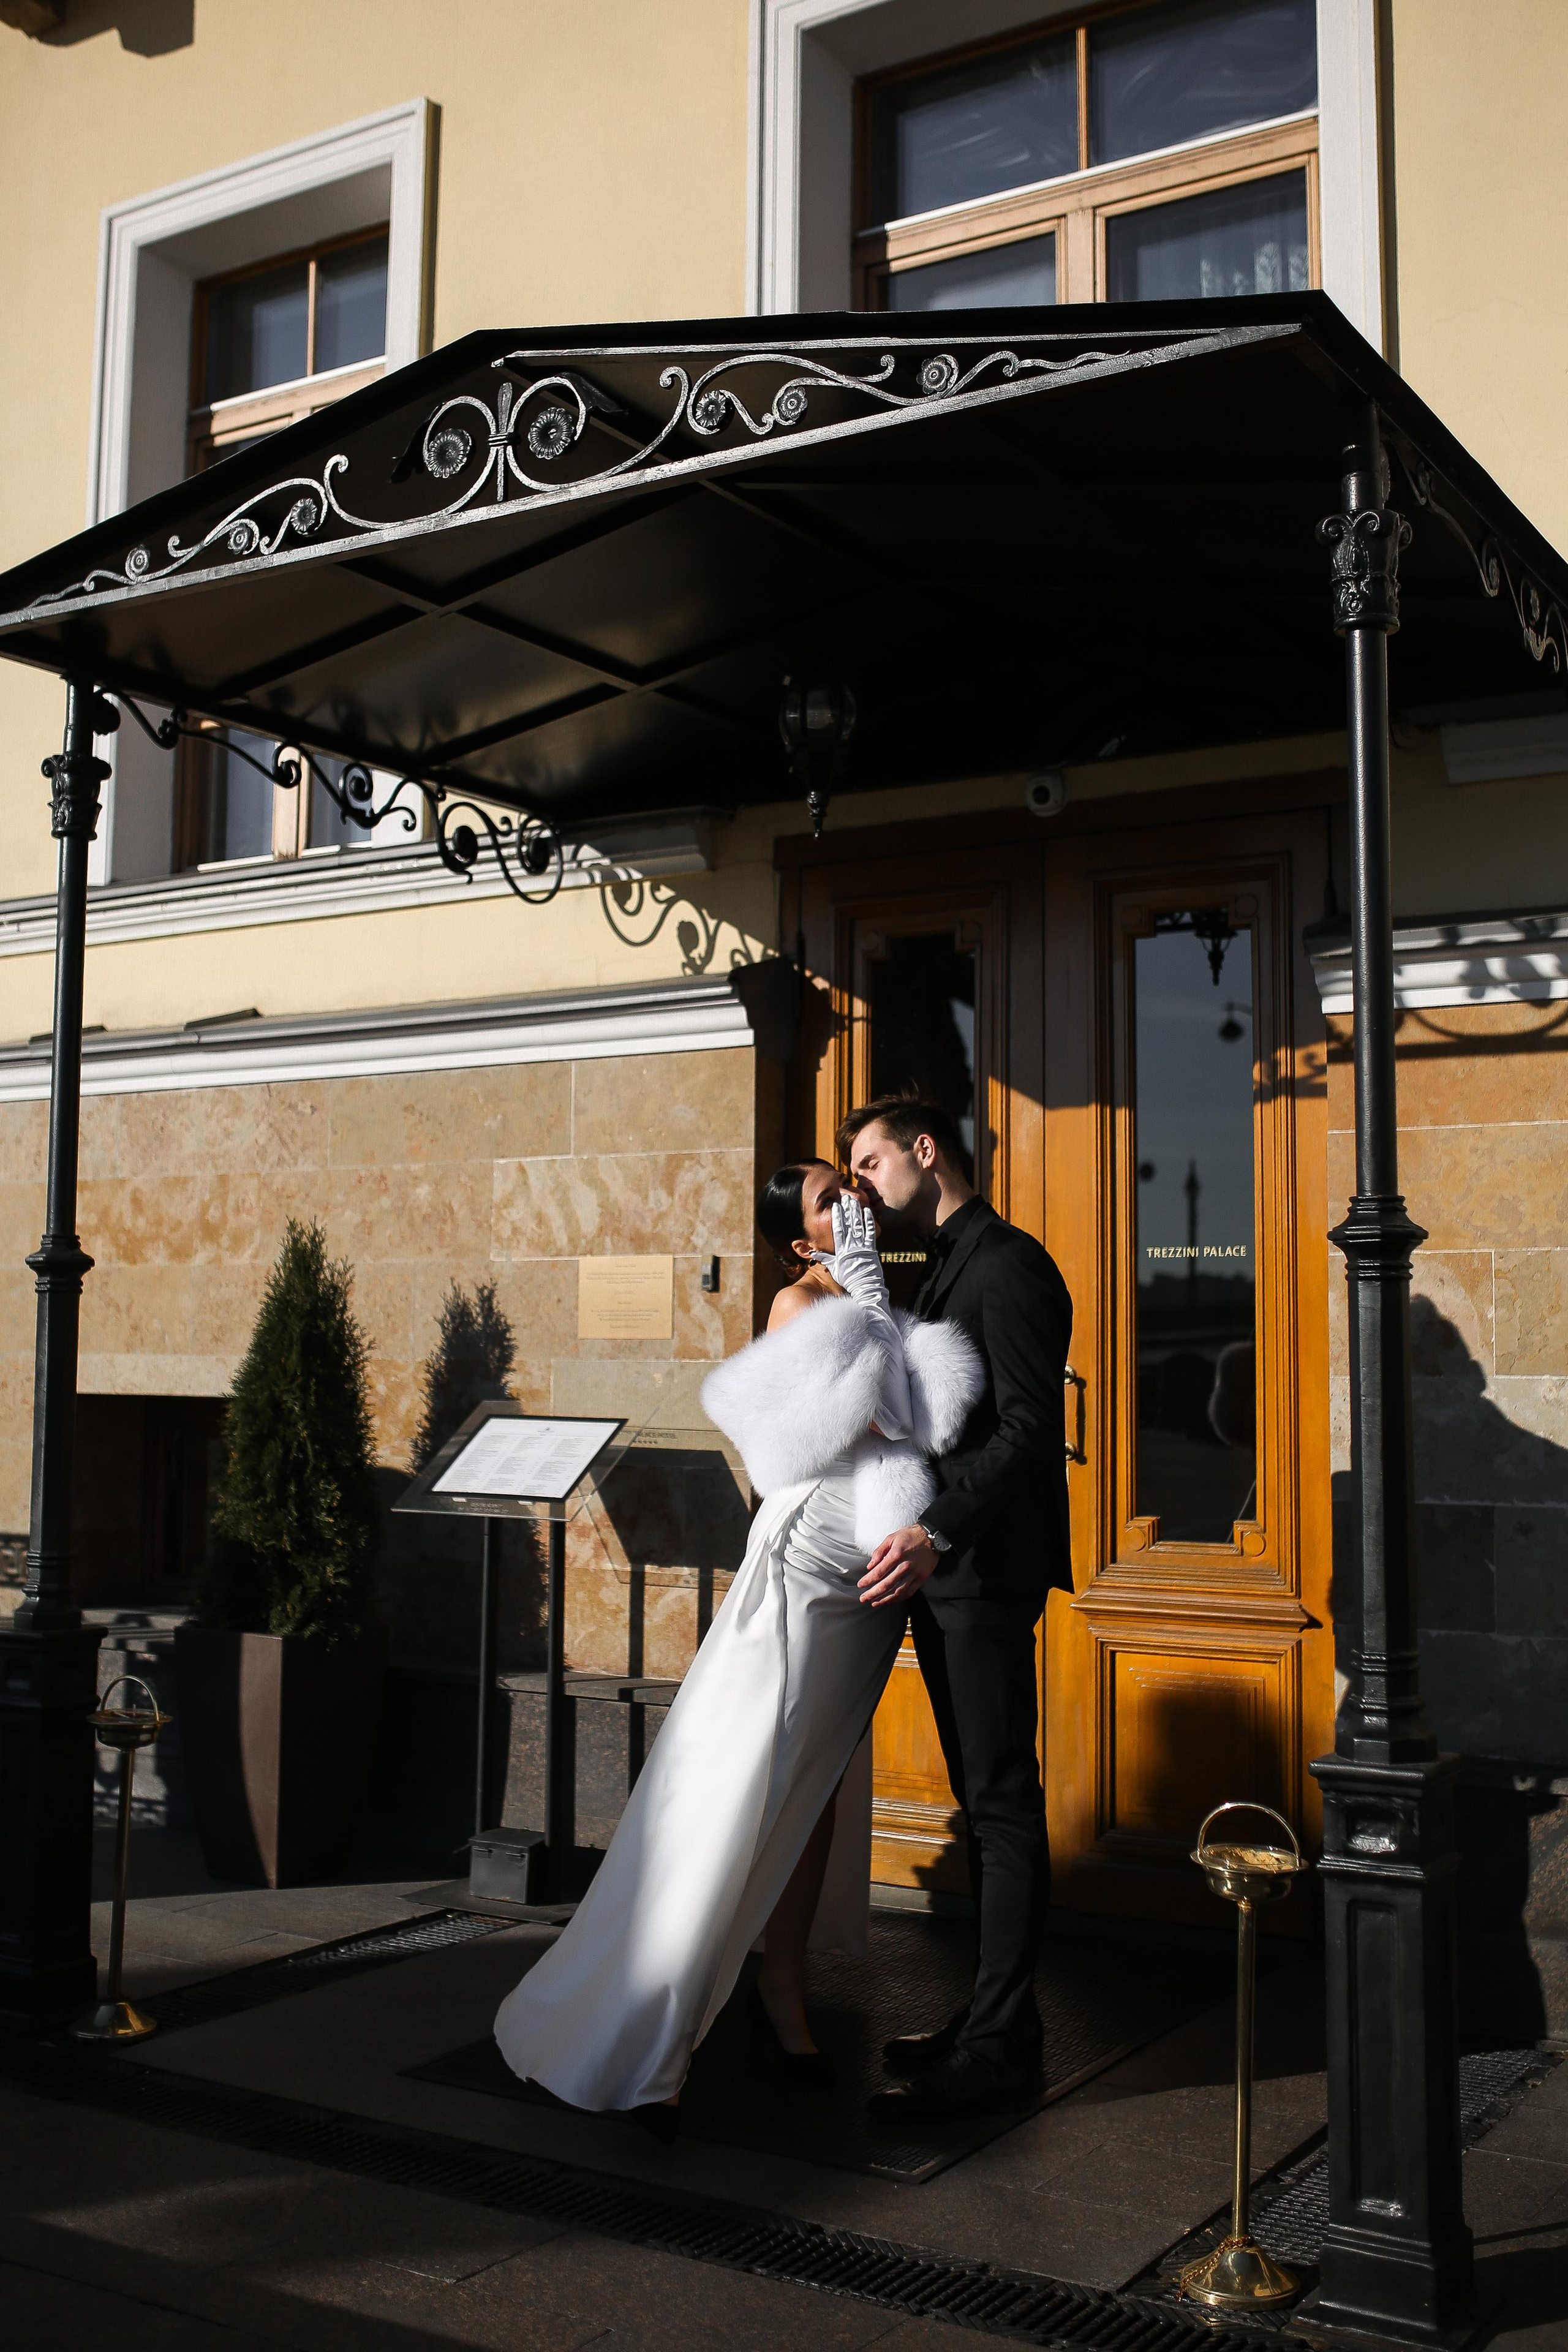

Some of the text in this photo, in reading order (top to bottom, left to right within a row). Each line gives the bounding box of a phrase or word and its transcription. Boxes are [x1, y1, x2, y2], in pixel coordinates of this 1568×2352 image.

[880, 1252, 927, 1263] TREZZINI
[1146, 1245, 1247, 1258] TREZZINI PALACE
